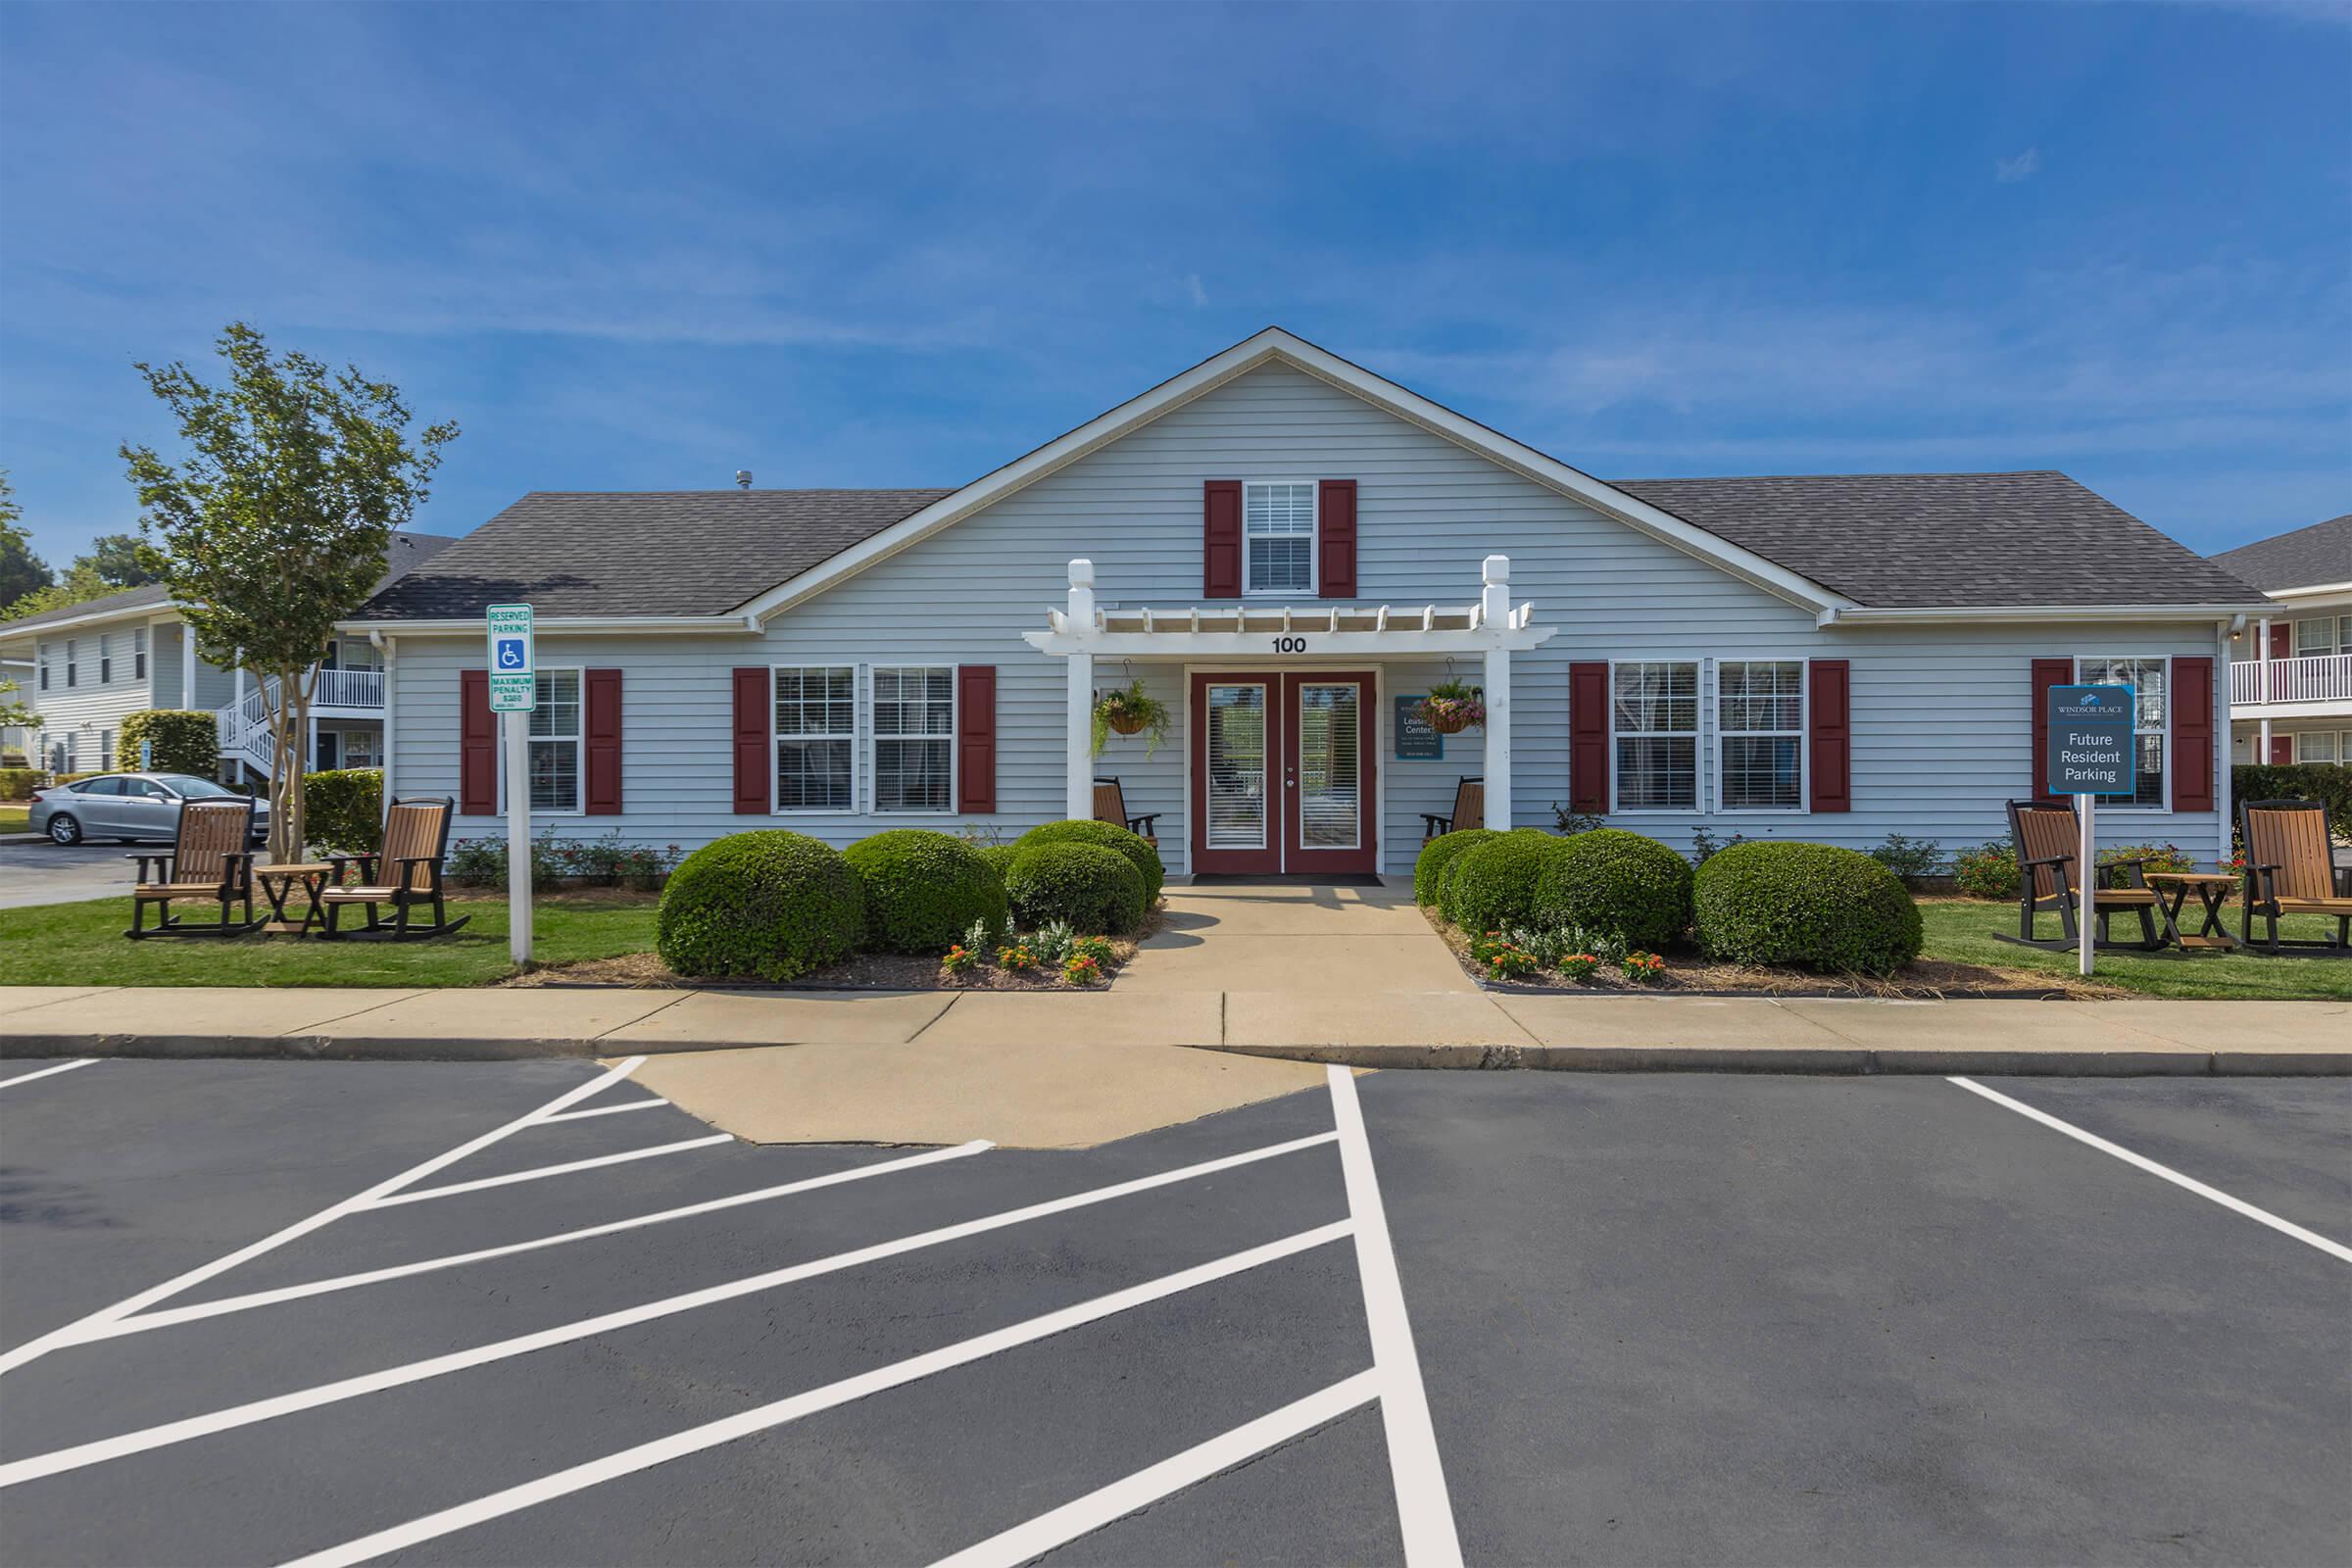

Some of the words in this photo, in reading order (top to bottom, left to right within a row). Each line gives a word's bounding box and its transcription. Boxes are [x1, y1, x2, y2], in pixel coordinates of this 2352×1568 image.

[491, 612, 529, 621] RESERVED
[493, 624, 528, 633] PARKING
[1272, 637, 1306, 653] 100
[1405, 725, 1433, 734] Center
[2069, 733, 2113, 746] Future
[2061, 751, 2121, 762] Resident
[2065, 767, 2116, 783] Parking
